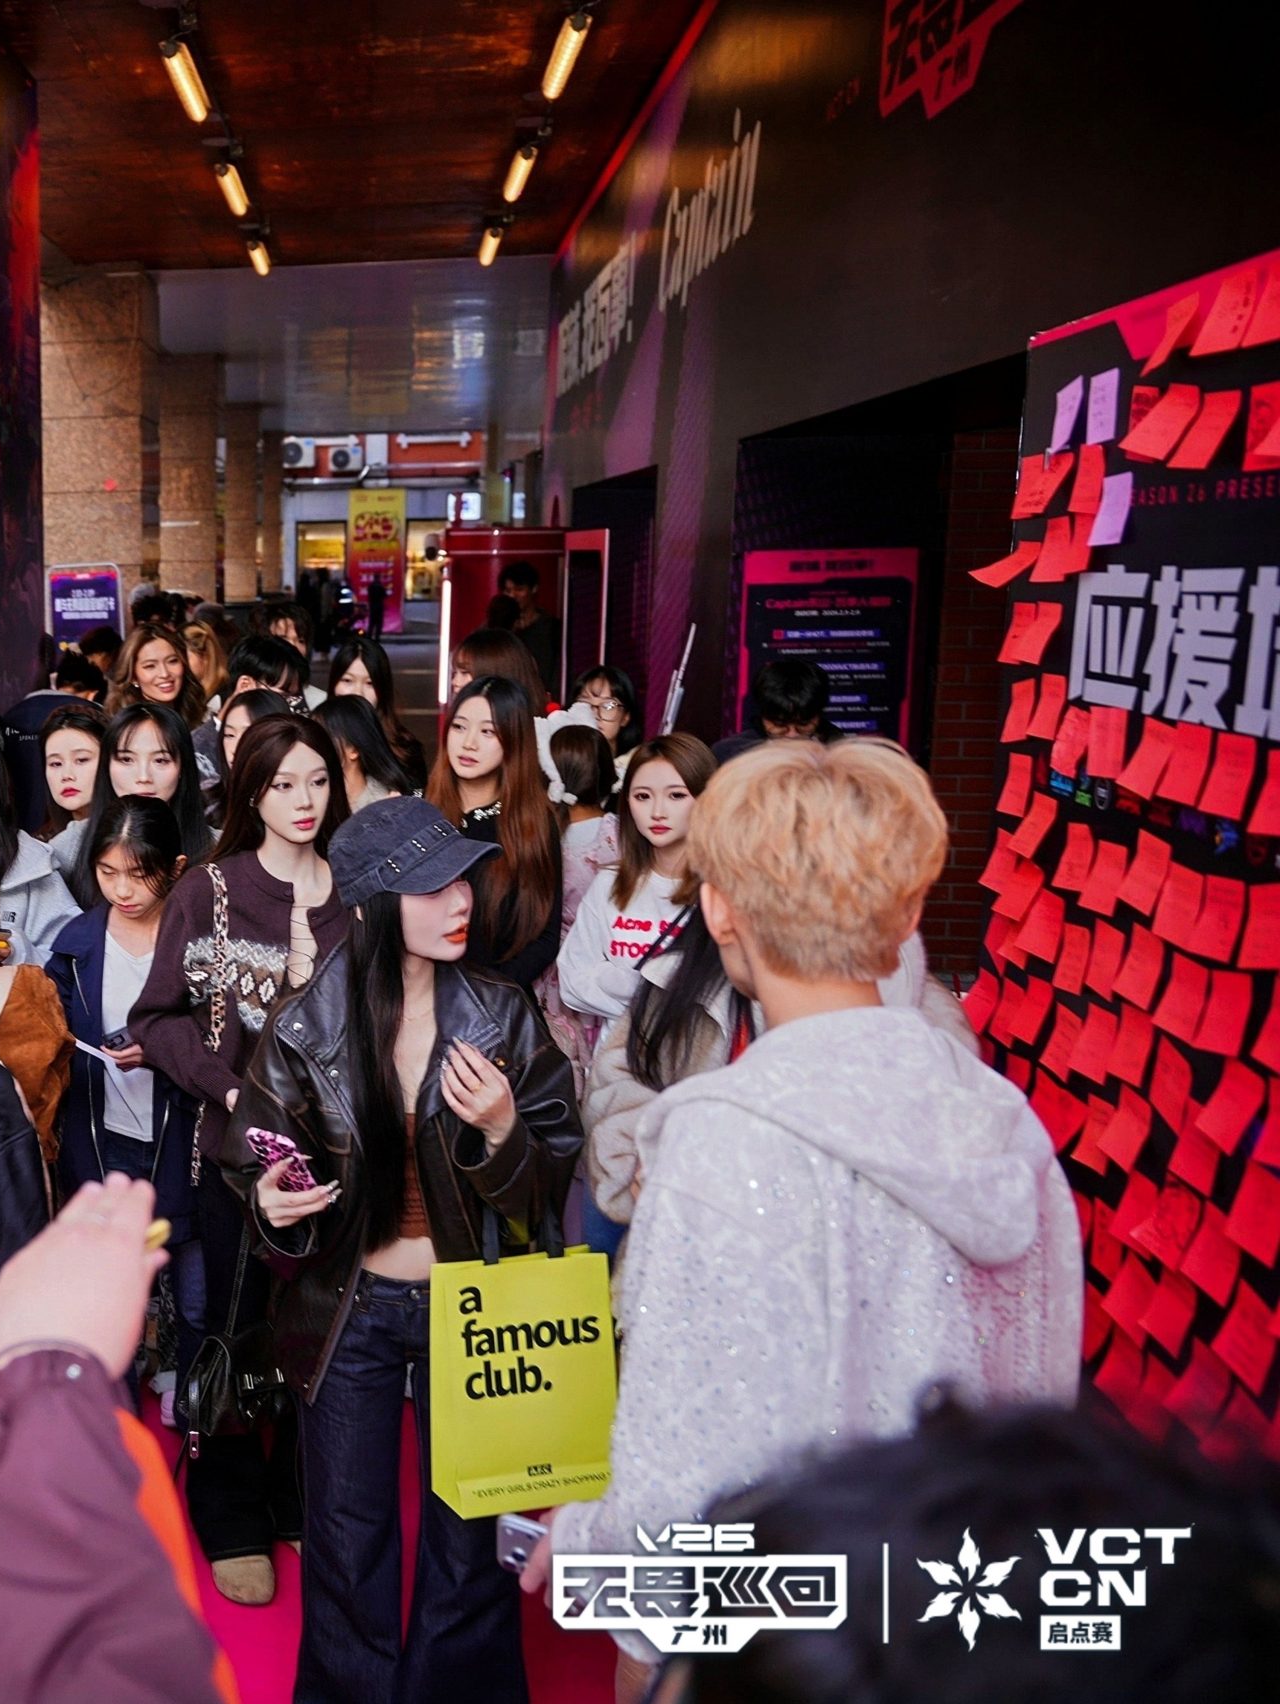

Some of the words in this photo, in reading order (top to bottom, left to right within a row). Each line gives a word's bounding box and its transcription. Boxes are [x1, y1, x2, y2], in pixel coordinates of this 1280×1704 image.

[1129, 484, 1179, 506] EASON
[1215, 475, 1280, 500] PRESE
[610, 940, 651, 958] STOC
[459, 1286, 482, 1314] a
[461, 1315, 600, 1357] famous
[465, 1356, 553, 1400] club.
